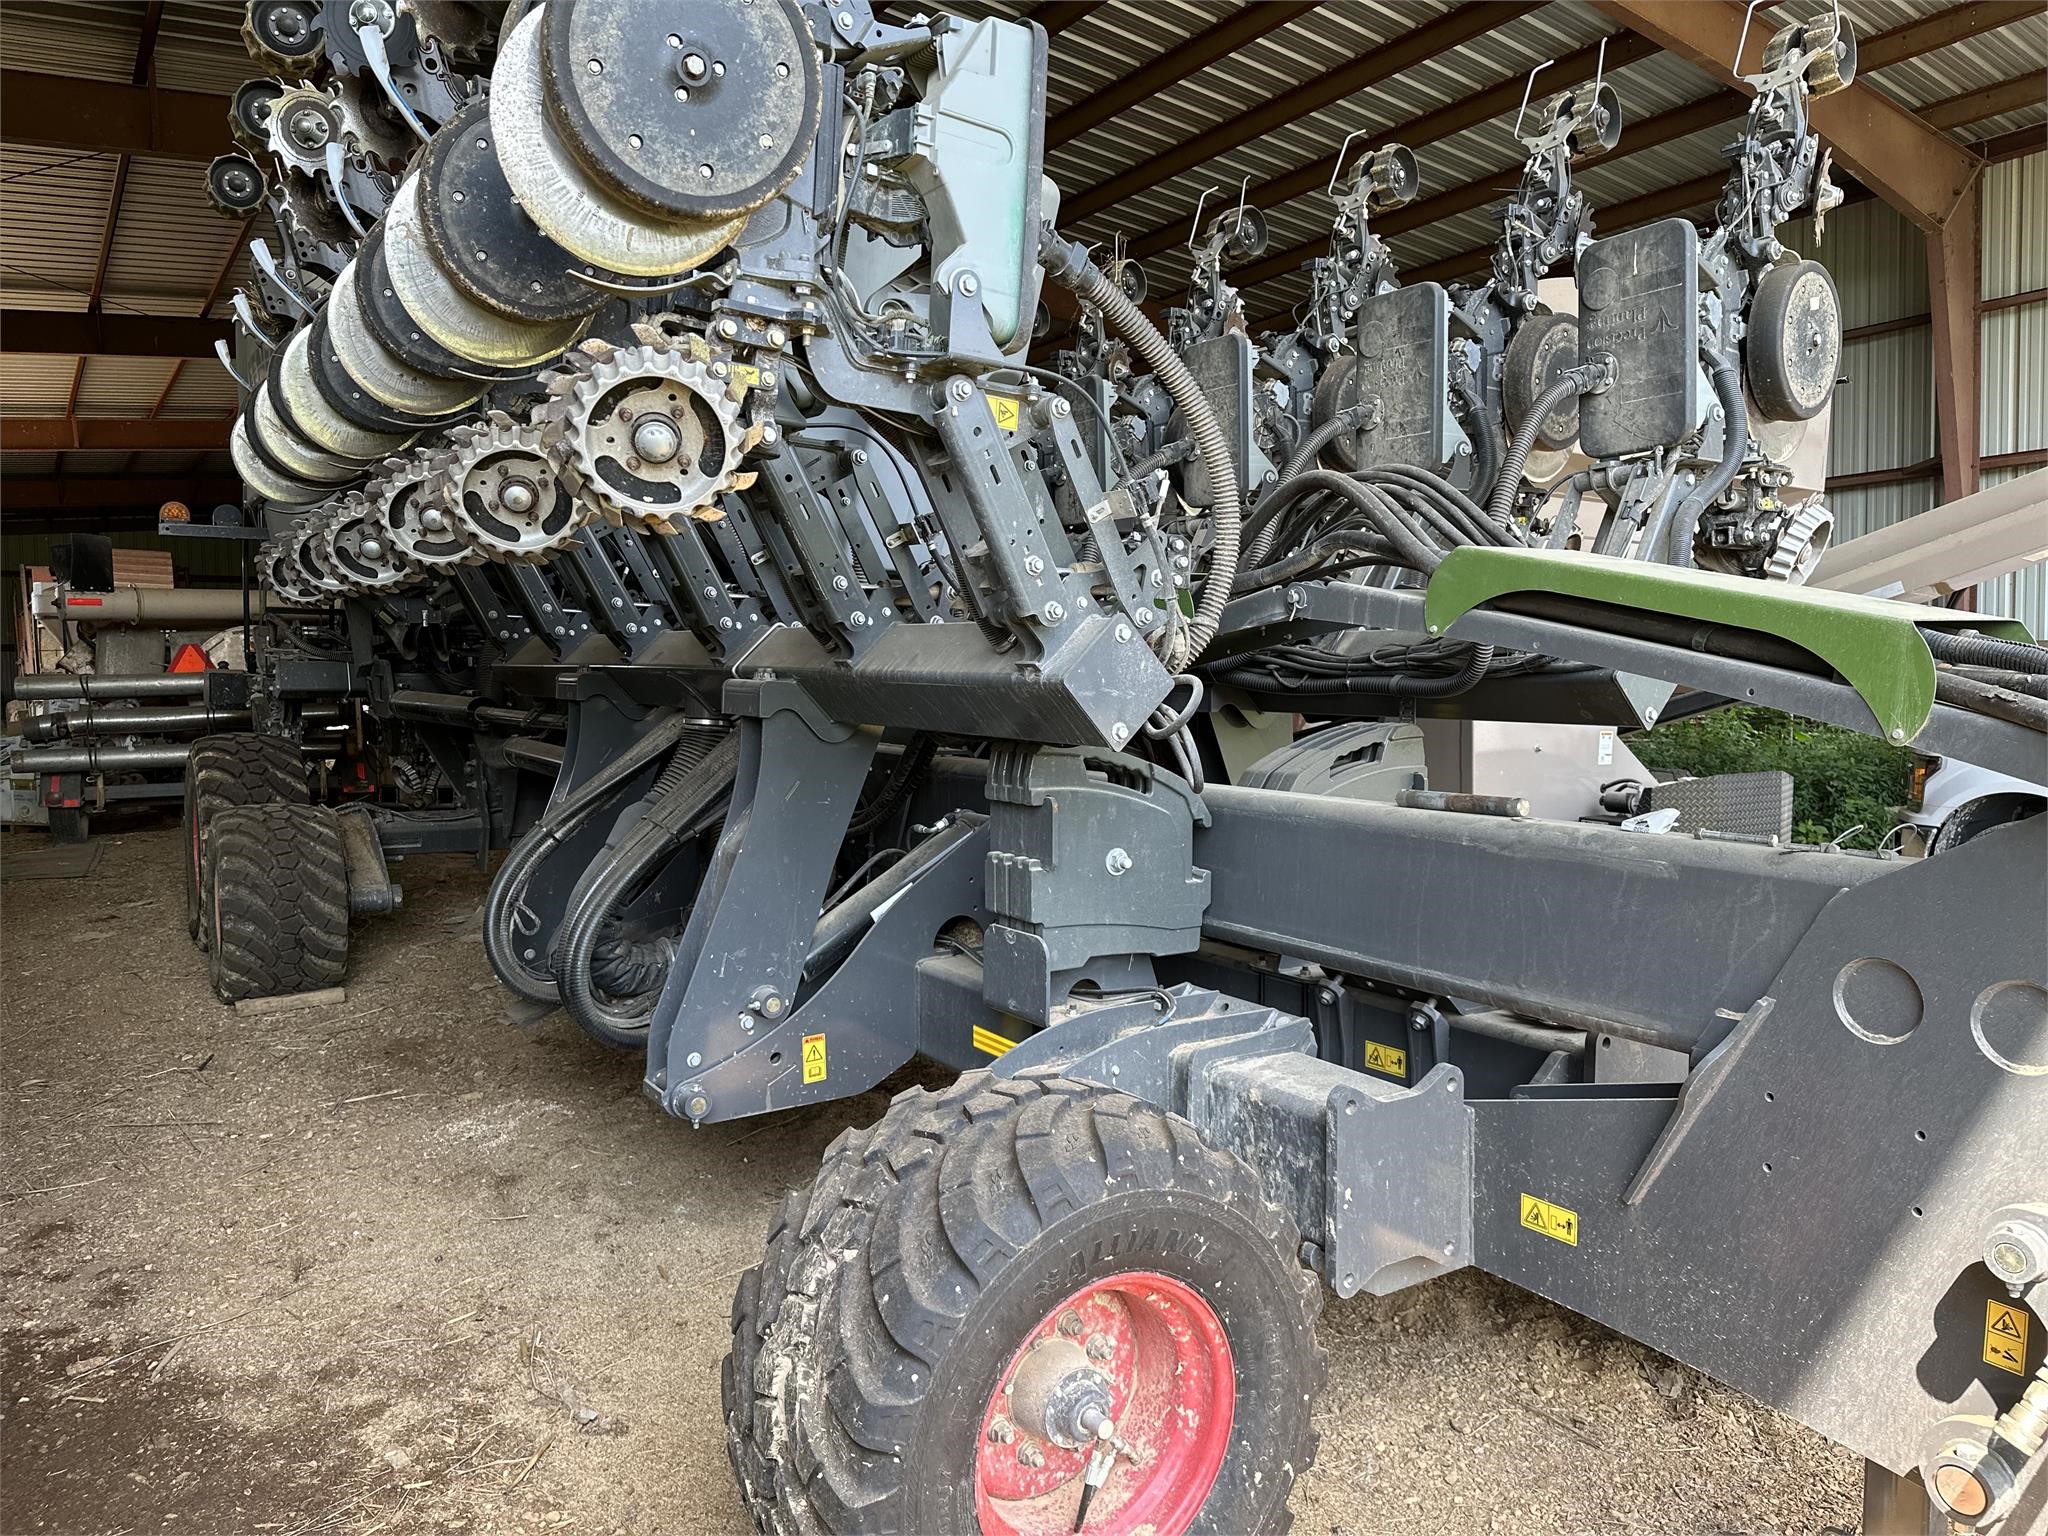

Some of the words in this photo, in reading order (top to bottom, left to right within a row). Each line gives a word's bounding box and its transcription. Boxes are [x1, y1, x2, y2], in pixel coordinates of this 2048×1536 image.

[1586, 304, 1648, 330] Planting
[1586, 326, 1647, 349] Precision
[1062, 1226, 1220, 1291] ALLIANCE
